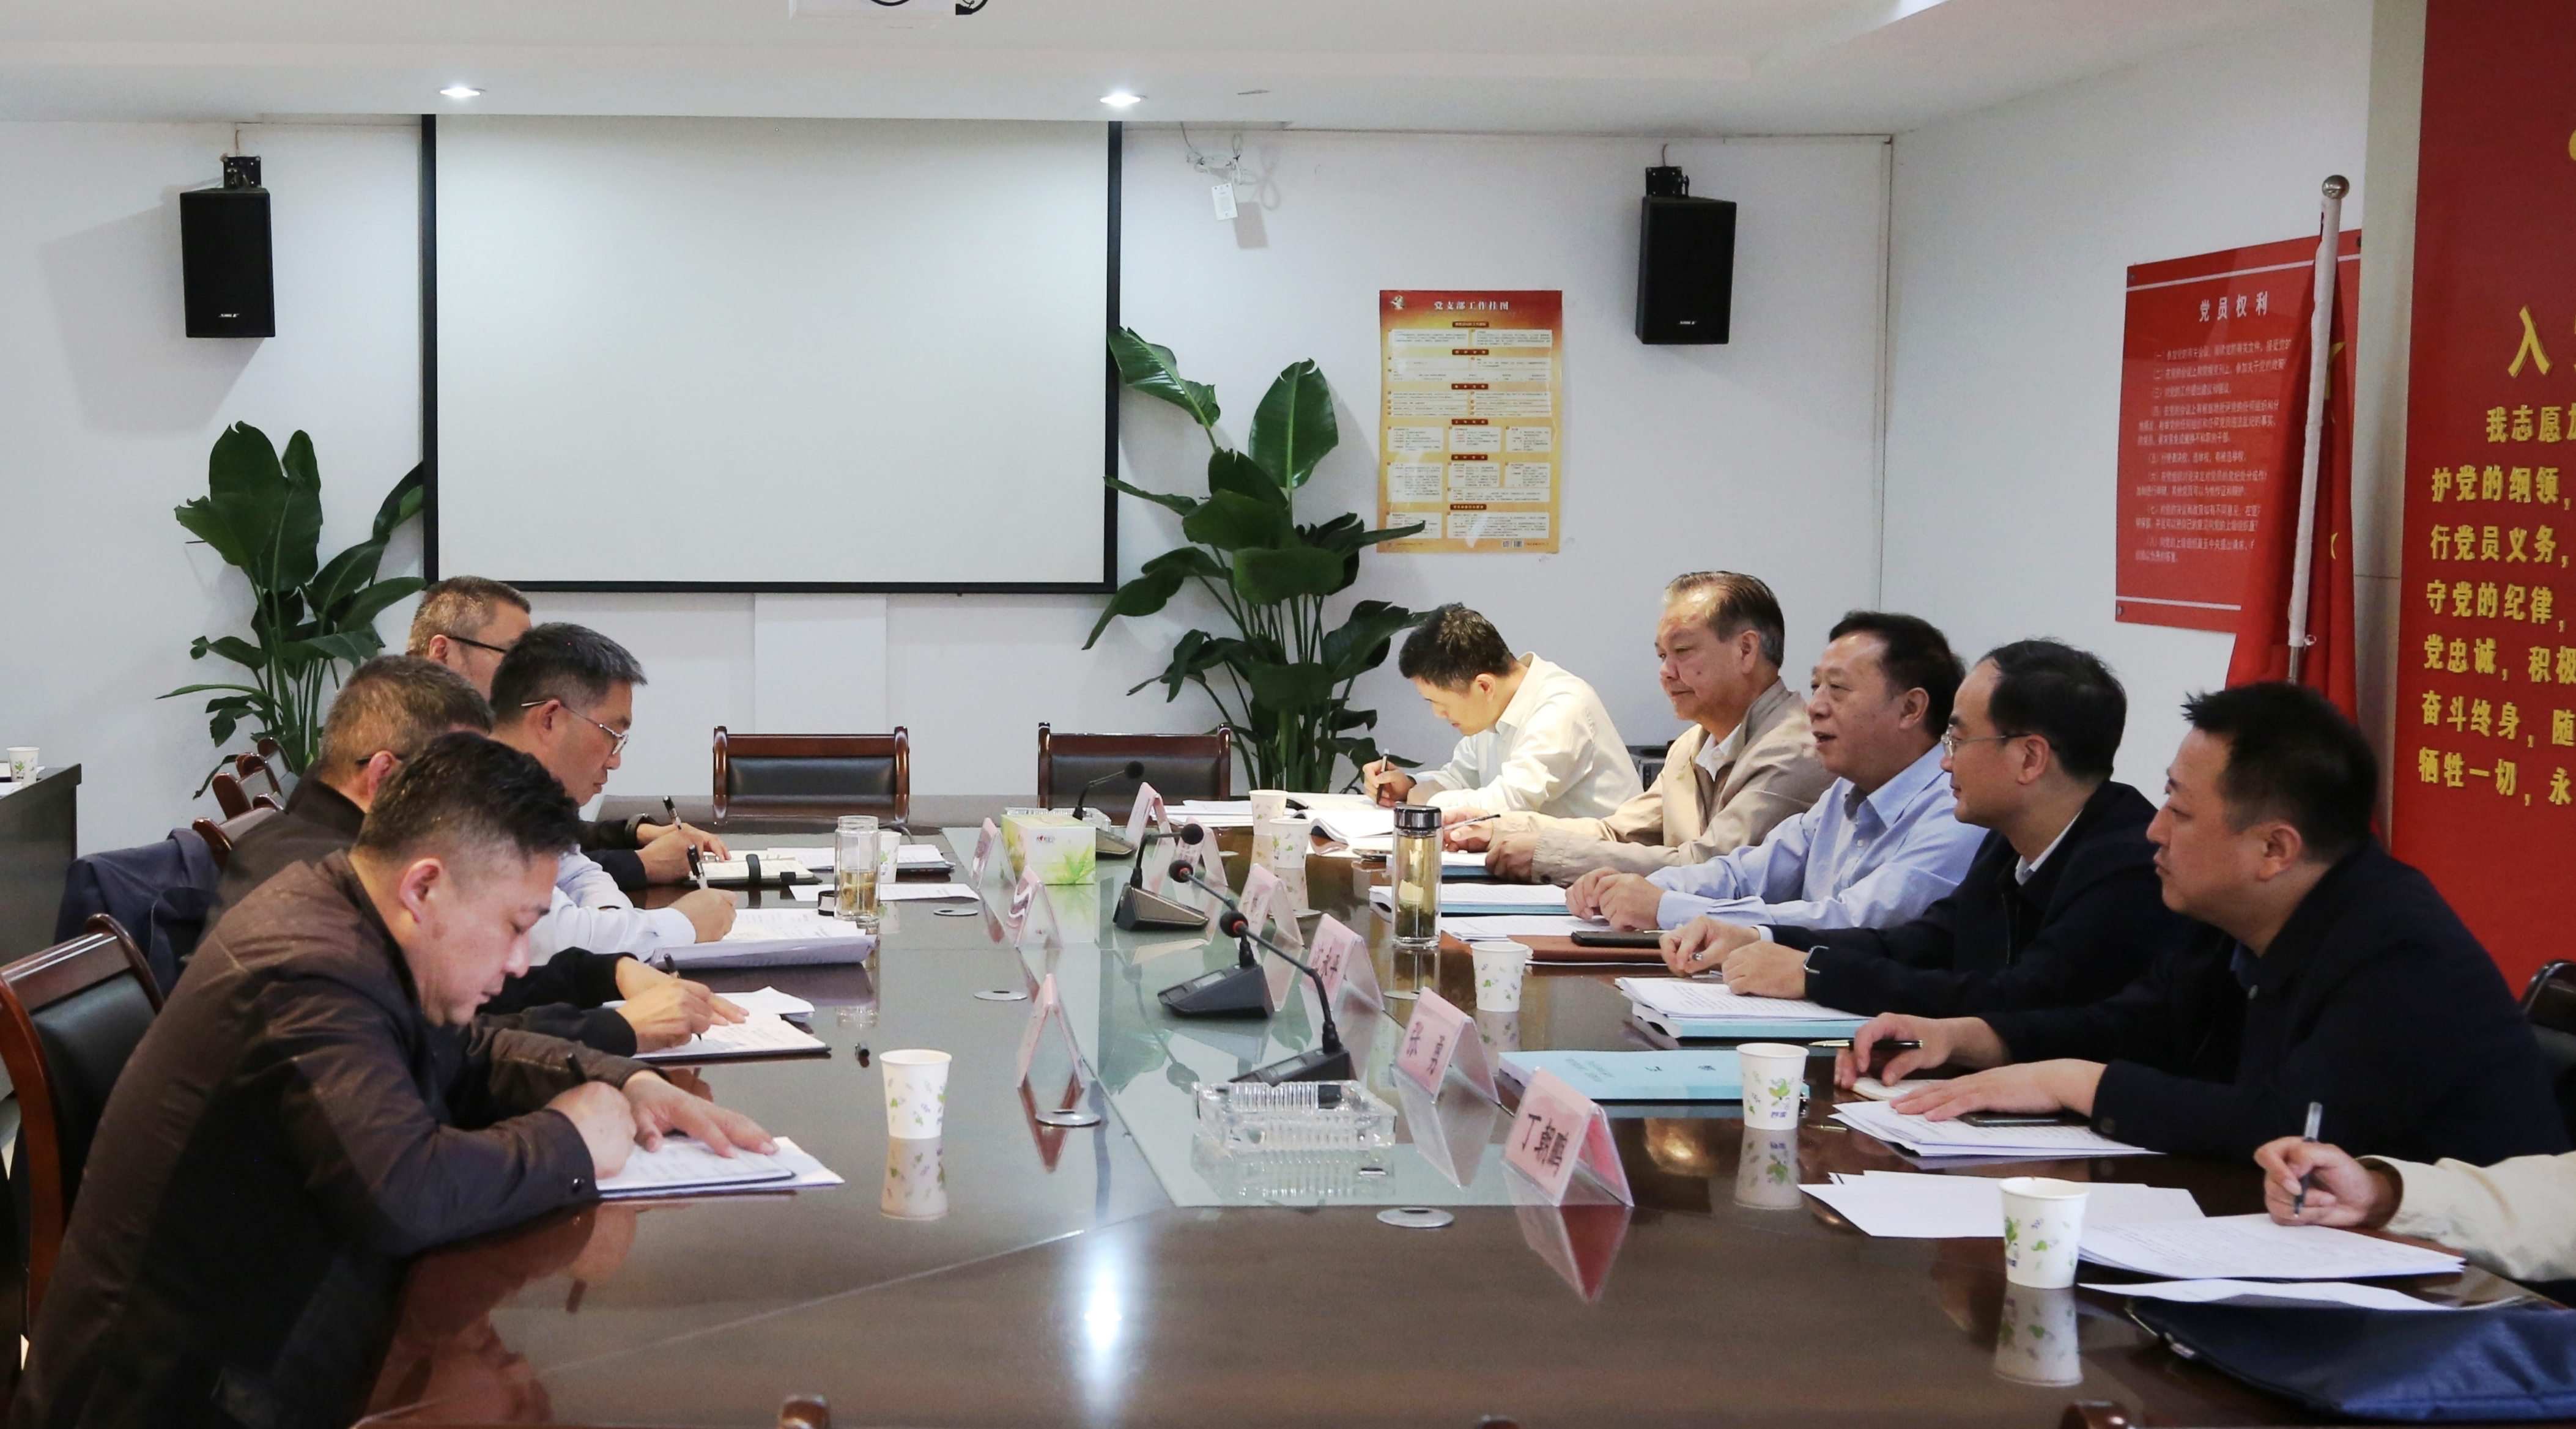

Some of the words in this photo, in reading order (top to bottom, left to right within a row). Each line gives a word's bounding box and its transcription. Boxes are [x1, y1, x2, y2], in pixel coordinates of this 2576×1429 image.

[1434, 301, 1509, 311] 党支部工作挂图
[2199, 290, 2268, 322] 党员权利
